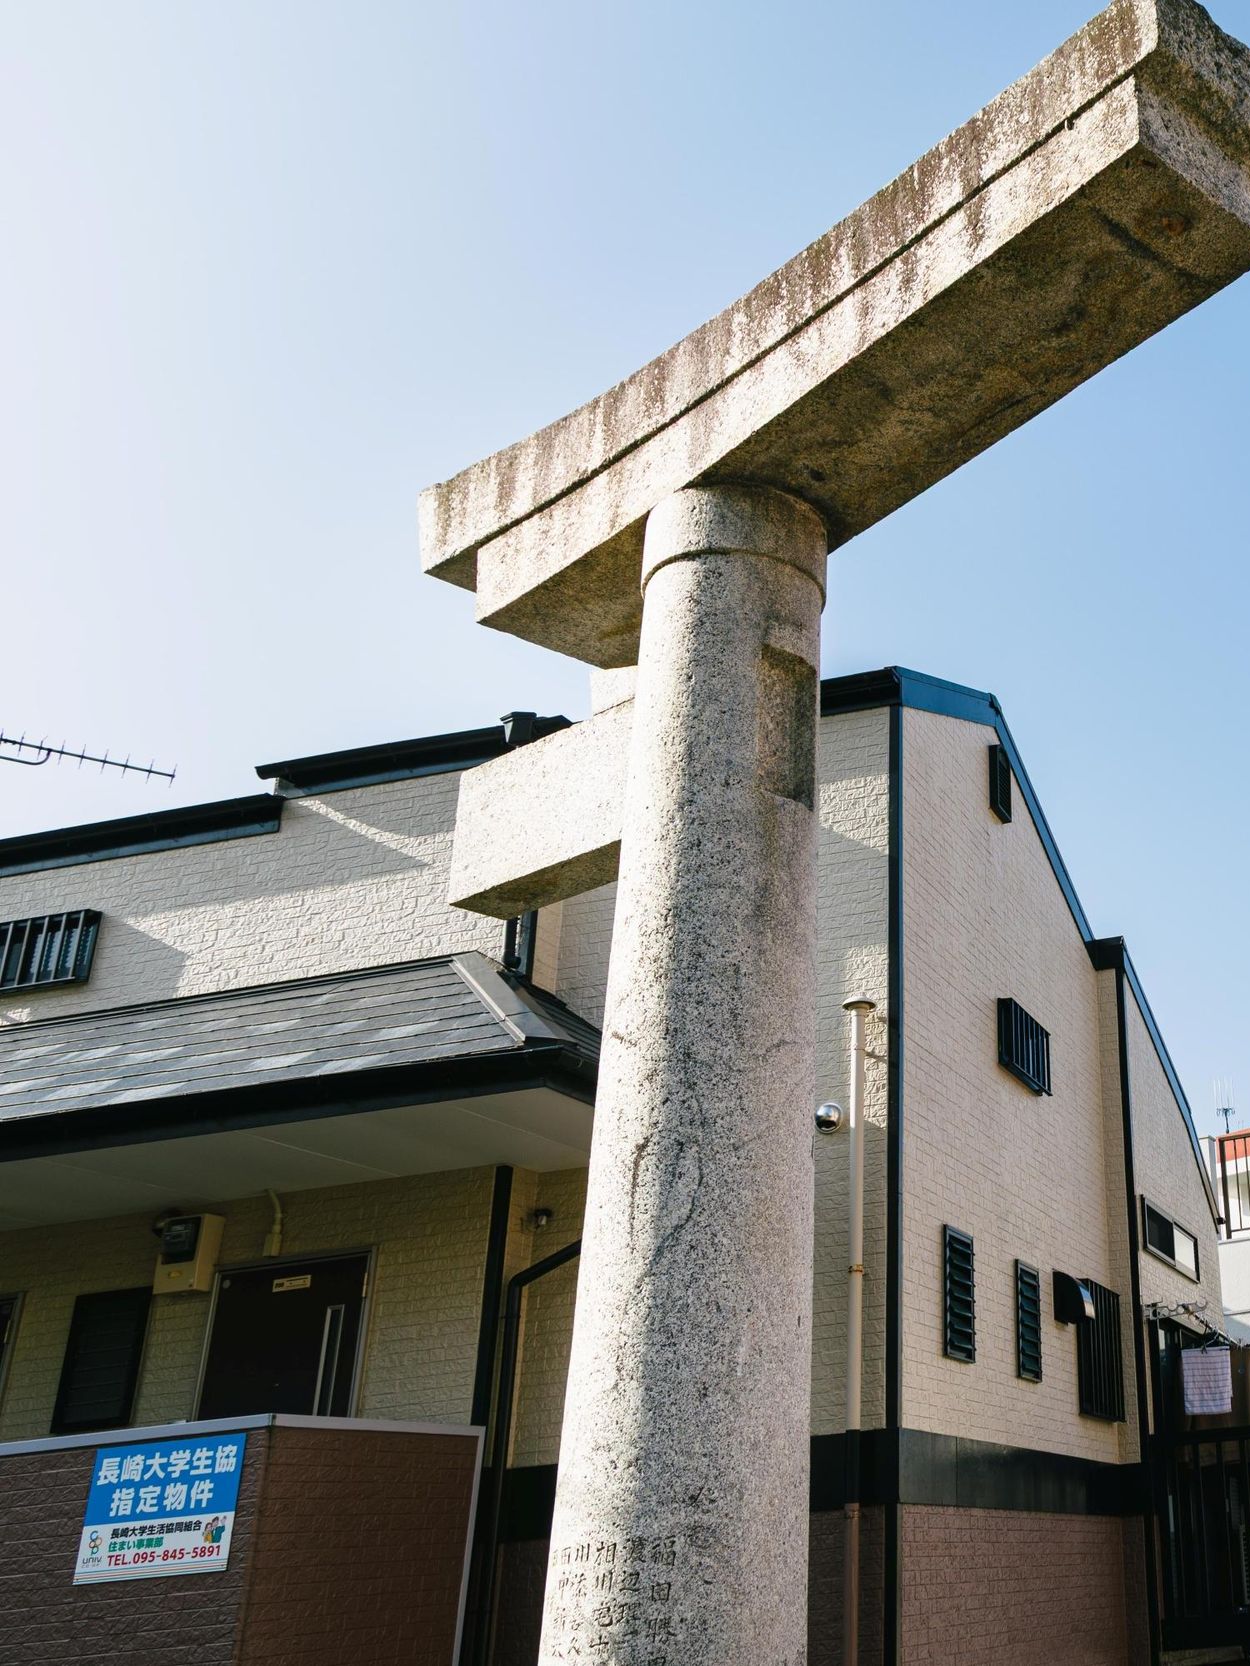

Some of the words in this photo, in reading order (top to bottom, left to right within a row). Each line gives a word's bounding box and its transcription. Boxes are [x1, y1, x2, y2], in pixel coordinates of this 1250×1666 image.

[96, 1445, 238, 1486] 長崎大学生協
[109, 1480, 214, 1517] 指定物件
[110, 1520, 203, 1540] 長崎大学生活協同組合
[108, 1536, 164, 1553] 住まい事業部
[107, 1545, 221, 1567] TEL.095-845-5891
